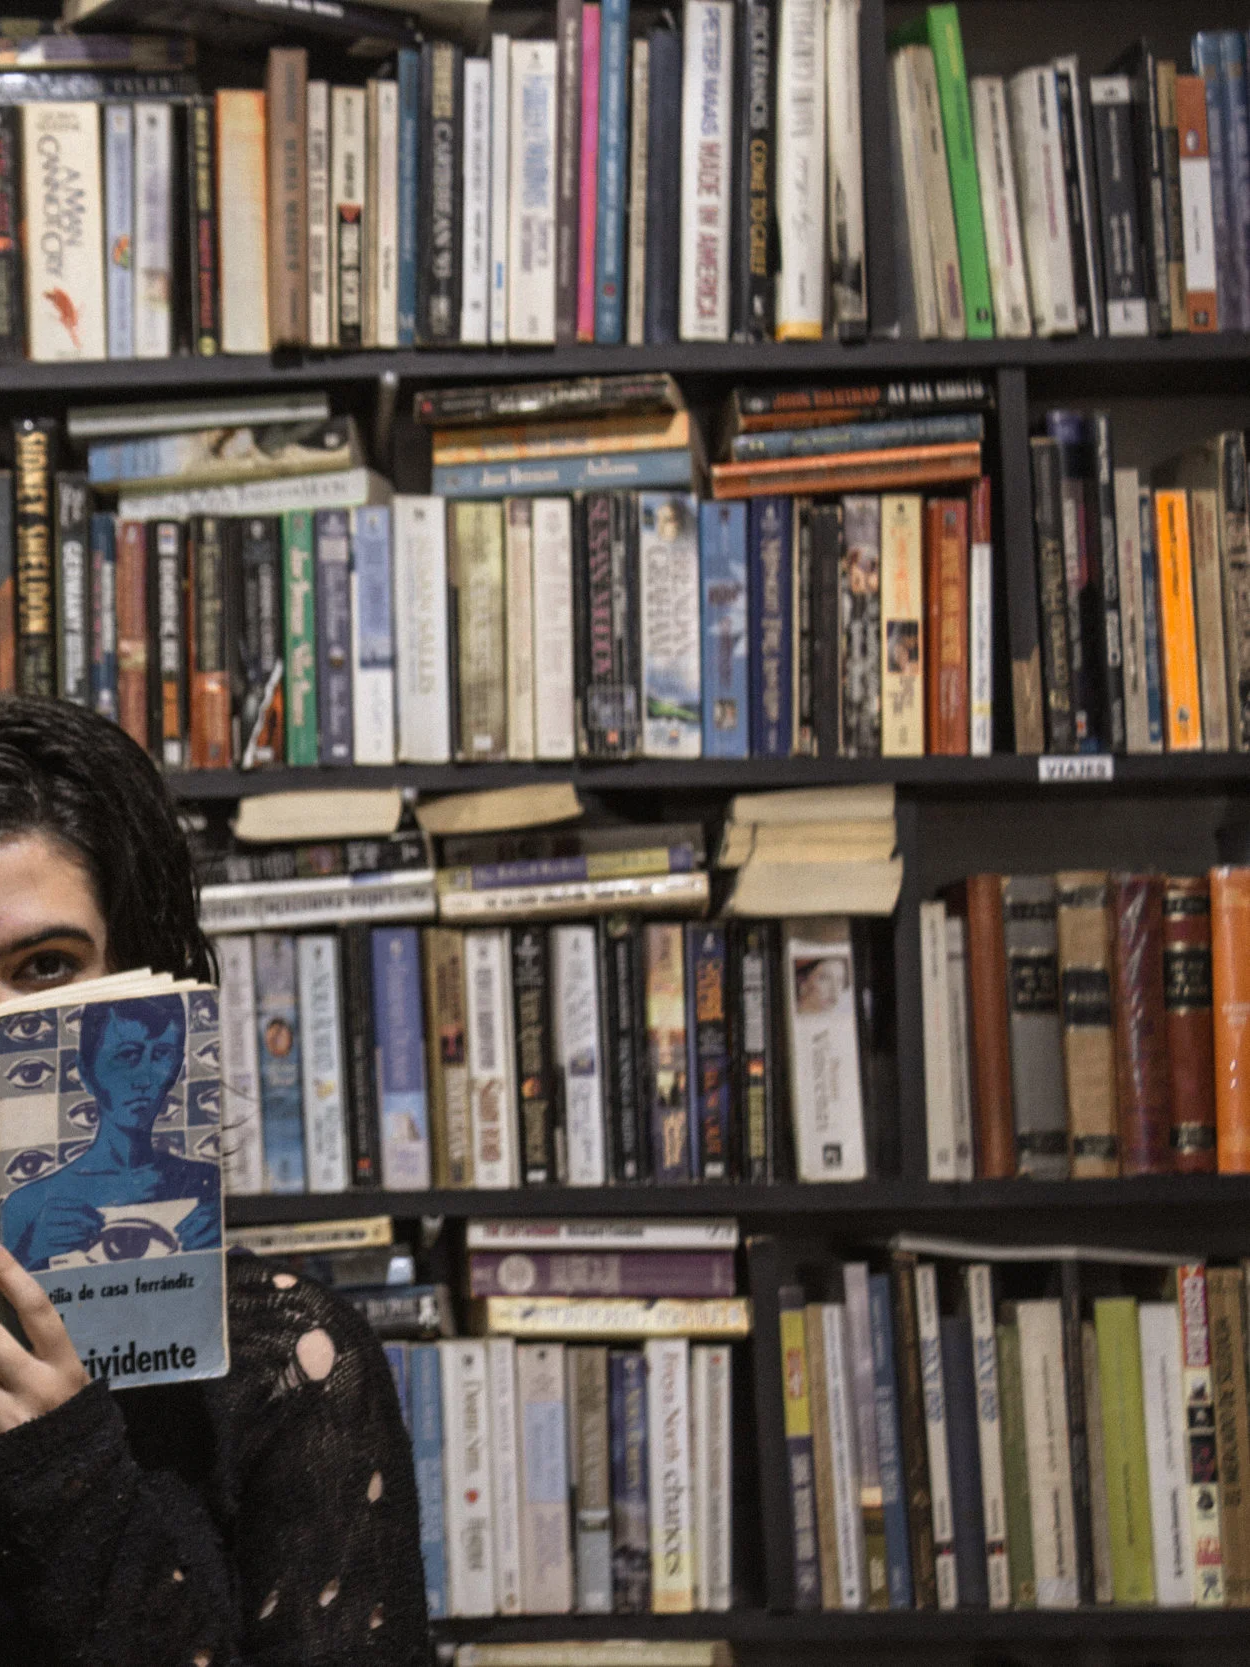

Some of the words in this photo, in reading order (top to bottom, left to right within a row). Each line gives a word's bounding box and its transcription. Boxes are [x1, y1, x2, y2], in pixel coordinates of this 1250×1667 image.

[698, 141, 721, 196] MADE
[697, 232, 719, 319] AMERICA
[17, 431, 48, 516] SIDNEY
[17, 524, 50, 635] SHELDON
[63, 540, 83, 631] GERMANY
[49, 1287, 72, 1304] tilia
[78, 1283, 93, 1300] de
[101, 1284, 129, 1297] casa
[135, 1272, 194, 1292] ferrándiz
[82, 1340, 197, 1380] ividente
